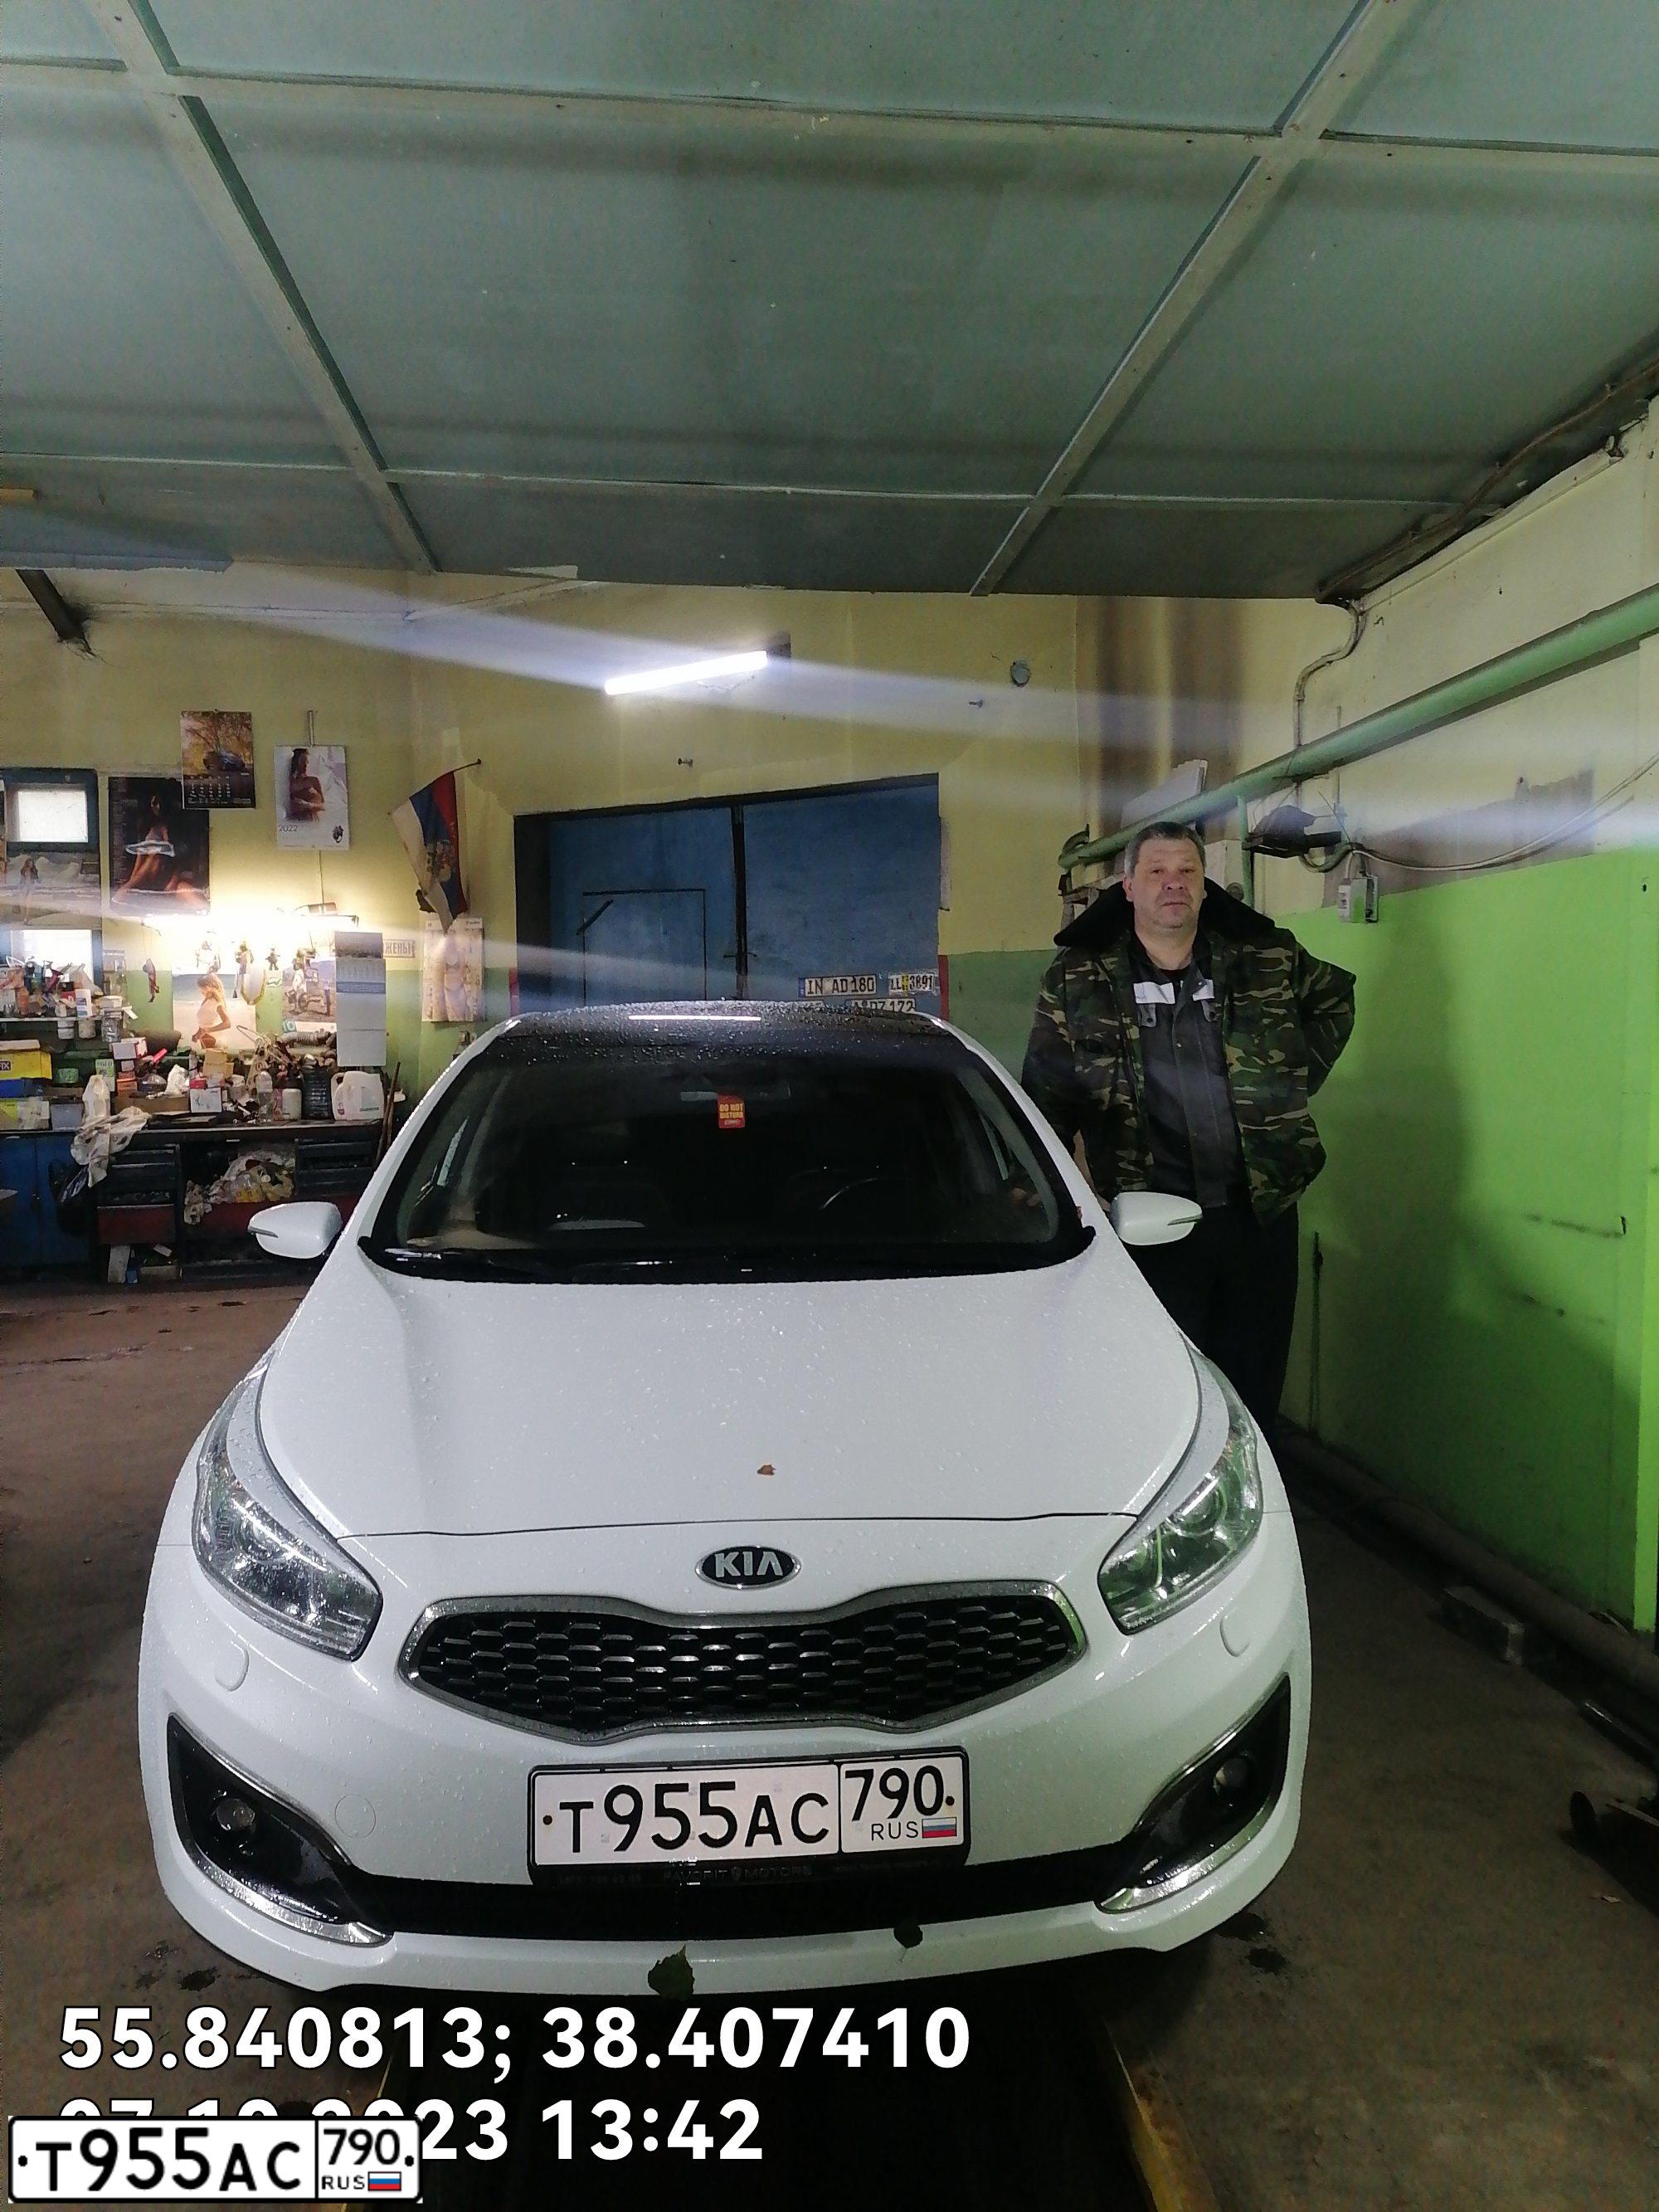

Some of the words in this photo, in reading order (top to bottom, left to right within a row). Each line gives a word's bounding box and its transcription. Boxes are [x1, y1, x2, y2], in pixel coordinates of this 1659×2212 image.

[808, 980, 823, 994] IN
[714, 1551, 784, 1577] KIA
[844, 1765, 945, 1822] 790
[871, 1820, 919, 1841] RUS
